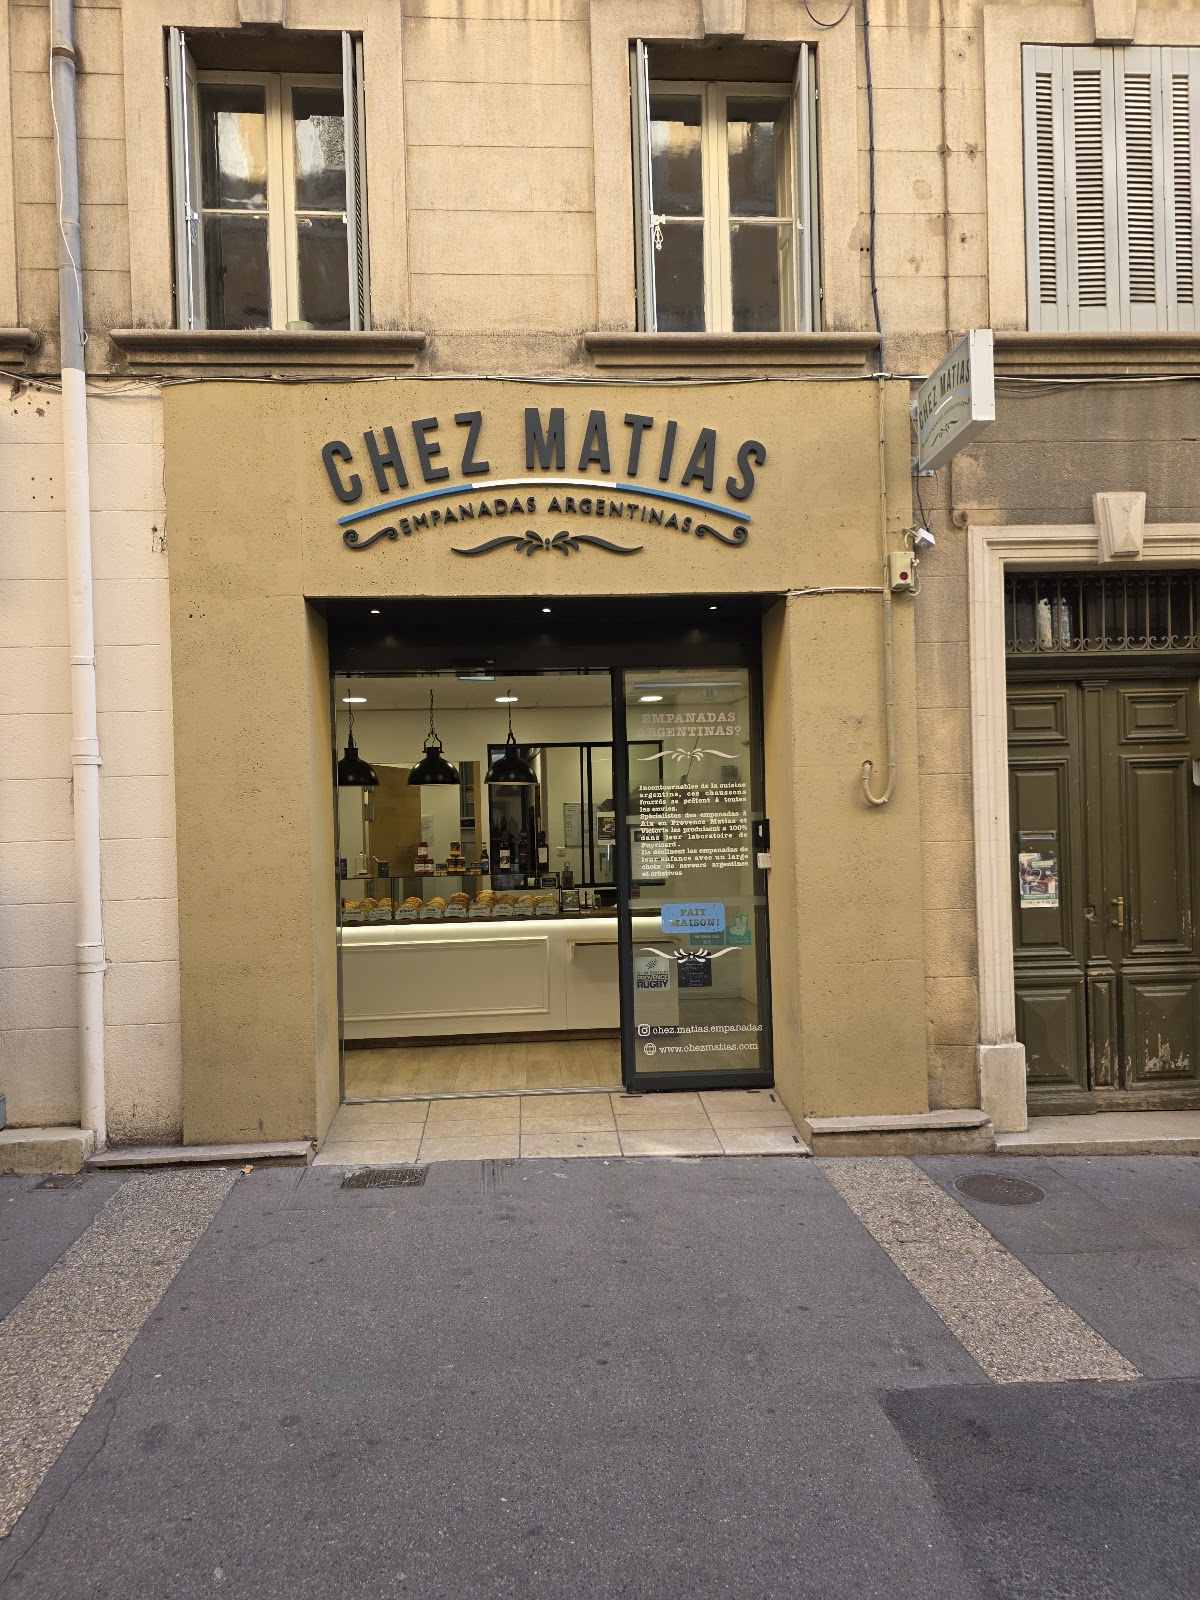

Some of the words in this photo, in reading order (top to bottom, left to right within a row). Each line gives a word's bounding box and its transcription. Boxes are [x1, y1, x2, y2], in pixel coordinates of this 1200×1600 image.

[919, 384, 938, 430] CHEZ
[940, 358, 970, 398] MATIAS
[321, 410, 490, 502] CHEZ
[524, 407, 767, 500] MATIAS
[399, 497, 536, 535] EMPANADAS
[548, 497, 693, 532] ARGENTINAS
[641, 712, 736, 724] EMPANADAS
[636, 725, 742, 738] ARGENTINAS?
[700, 811, 740, 819] empanadas
[683, 826, 721, 834] produisent
[712, 861, 749, 869] argentines
[680, 909, 707, 917] FAIT
[671, 919, 720, 927] MAISON!
[637, 981, 668, 989] RUGBY
[653, 1024, 763, 1034] chez.matias.empanadas
[659, 1043, 758, 1054] www.chezmatias.com
